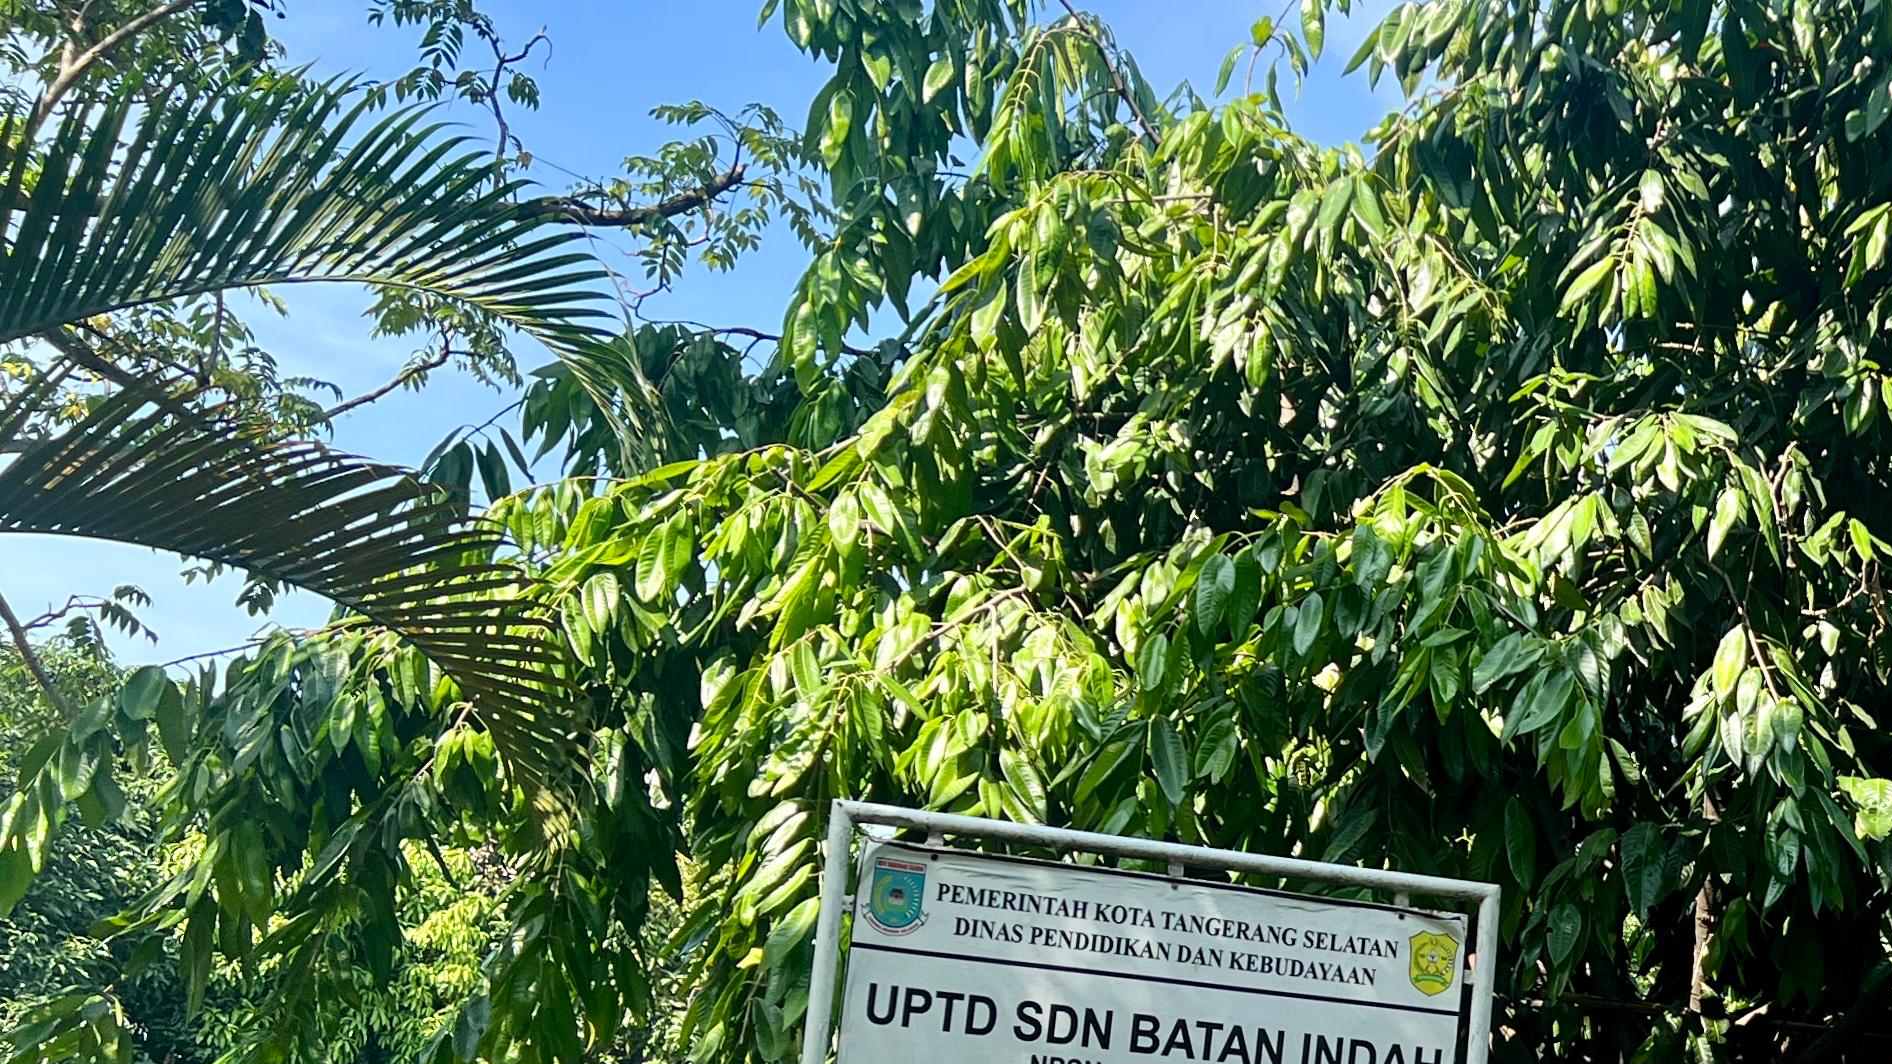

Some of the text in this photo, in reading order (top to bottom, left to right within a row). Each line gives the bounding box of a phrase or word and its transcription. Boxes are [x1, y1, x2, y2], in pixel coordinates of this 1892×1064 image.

[936, 883, 1398, 958] PEMERINTAH KOTA TANGERANG SELATAN
[954, 917, 1023, 943] DINAS
[1029, 926, 1171, 961] PENDIDIKAN
[1177, 945, 1223, 968] DAN
[1229, 952, 1376, 985] KEBUDAYAAN
[867, 983, 997, 1035] UPTD
[1013, 1001, 1113, 1049] SDN
